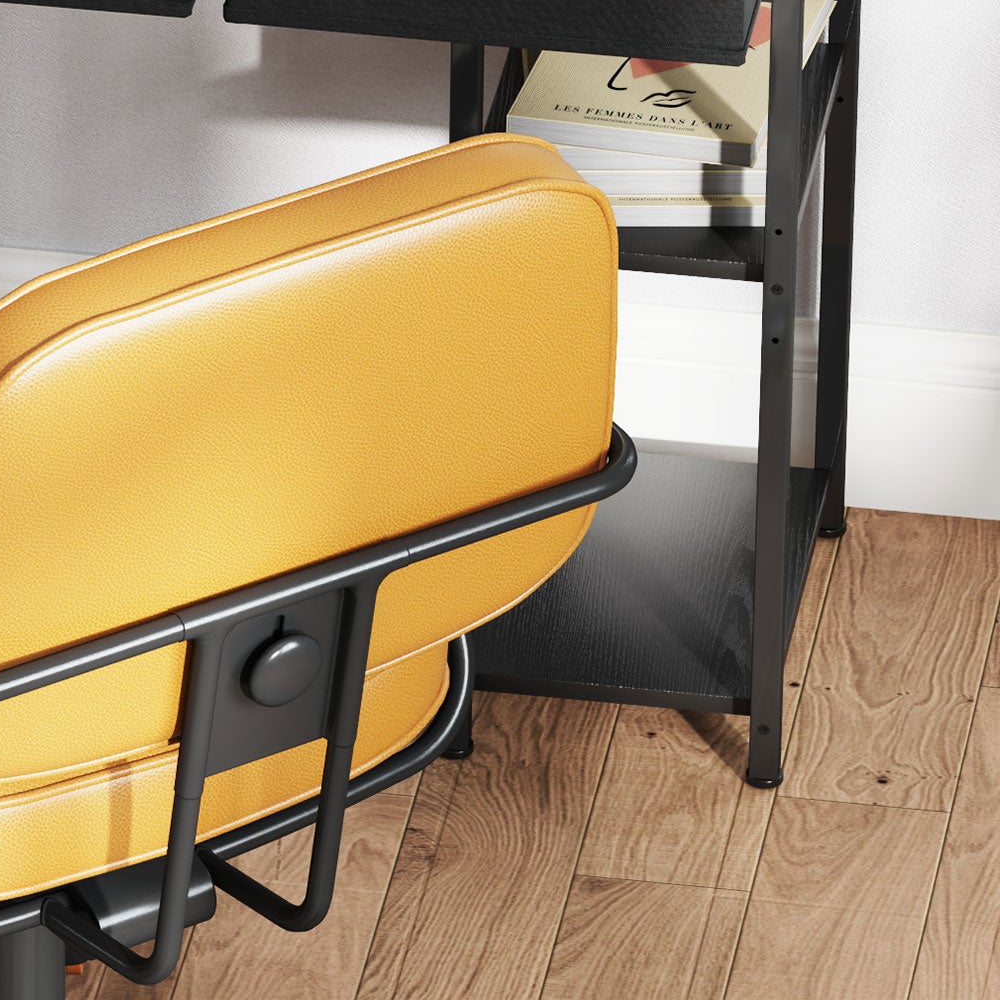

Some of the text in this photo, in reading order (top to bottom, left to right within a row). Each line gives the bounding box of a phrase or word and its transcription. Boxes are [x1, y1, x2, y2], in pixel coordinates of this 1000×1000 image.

[554, 104, 733, 131] LES FEMMES DANS L'ART
